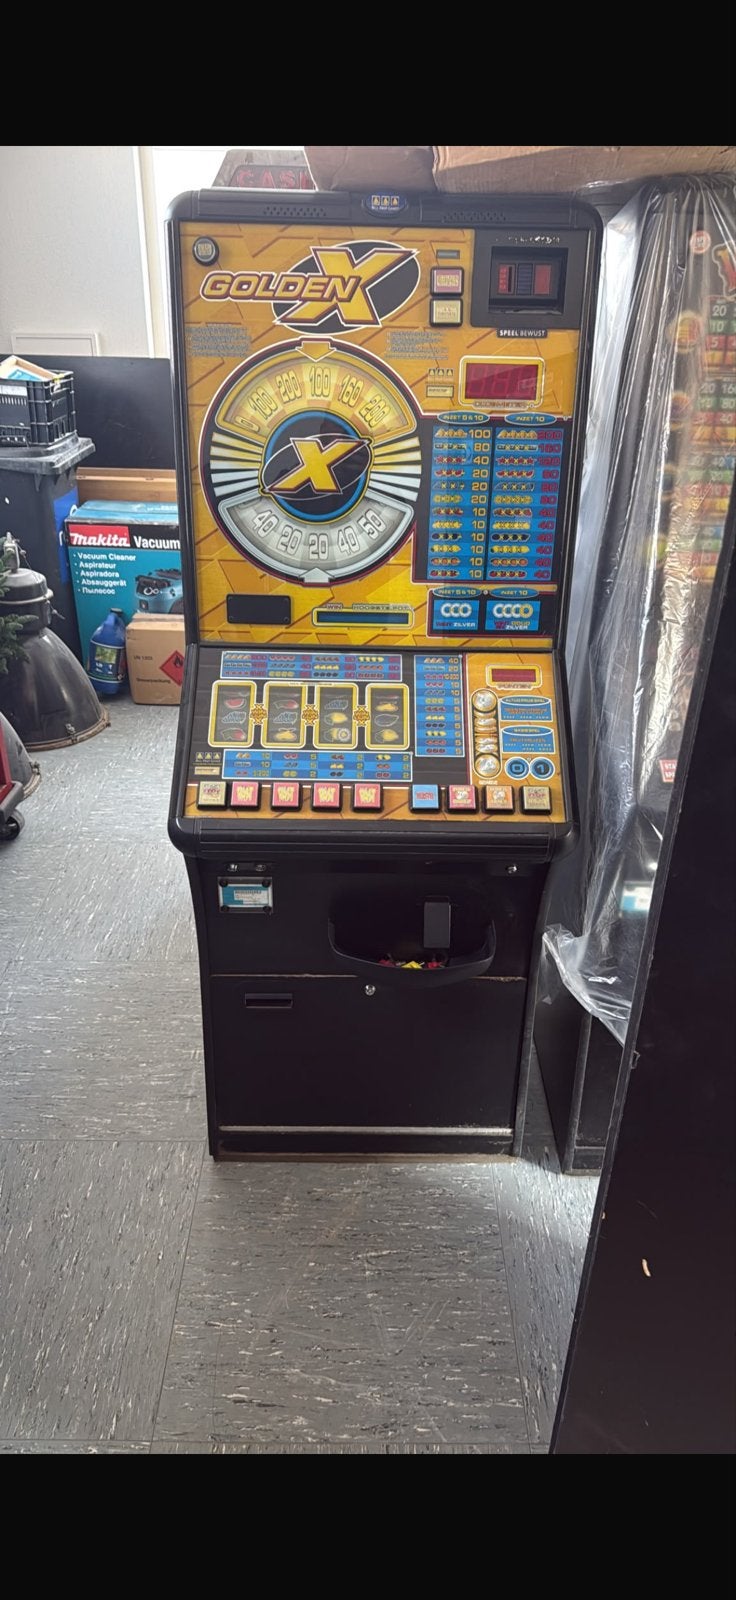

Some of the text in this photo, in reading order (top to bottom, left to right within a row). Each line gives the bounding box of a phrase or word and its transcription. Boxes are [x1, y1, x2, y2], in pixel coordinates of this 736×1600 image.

[200, 246, 420, 327] GOLDEN X
[712, 305, 727, 317] 20
[274, 370, 302, 403] 200
[309, 366, 331, 398] 100
[337, 373, 364, 407] 160
[248, 386, 279, 420] 100
[358, 393, 390, 428] 200
[469, 430, 490, 438] 100
[474, 443, 490, 452] 80
[473, 456, 490, 464] 40
[265, 438, 372, 494] X
[472, 469, 488, 478] 20
[472, 482, 488, 490] 20
[471, 495, 487, 504] 20
[472, 508, 486, 516] 10
[252, 510, 279, 537] 40
[357, 509, 387, 539] 50
[472, 520, 486, 529] 10
[70, 532, 181, 550] makita Vacuum
[276, 526, 302, 555] 20
[337, 525, 360, 554] 40
[471, 533, 485, 541] 10
[308, 532, 330, 560] 20
[470, 545, 484, 554] 10
[78, 552, 136, 561] Vacuum Cleaner
[80, 562, 116, 570] Aspirateur
[469, 558, 483, 566] 10
[80, 570, 120, 578] Aspiradora
[469, 570, 482, 578] 10
[82, 579, 126, 588] Absauggerät
